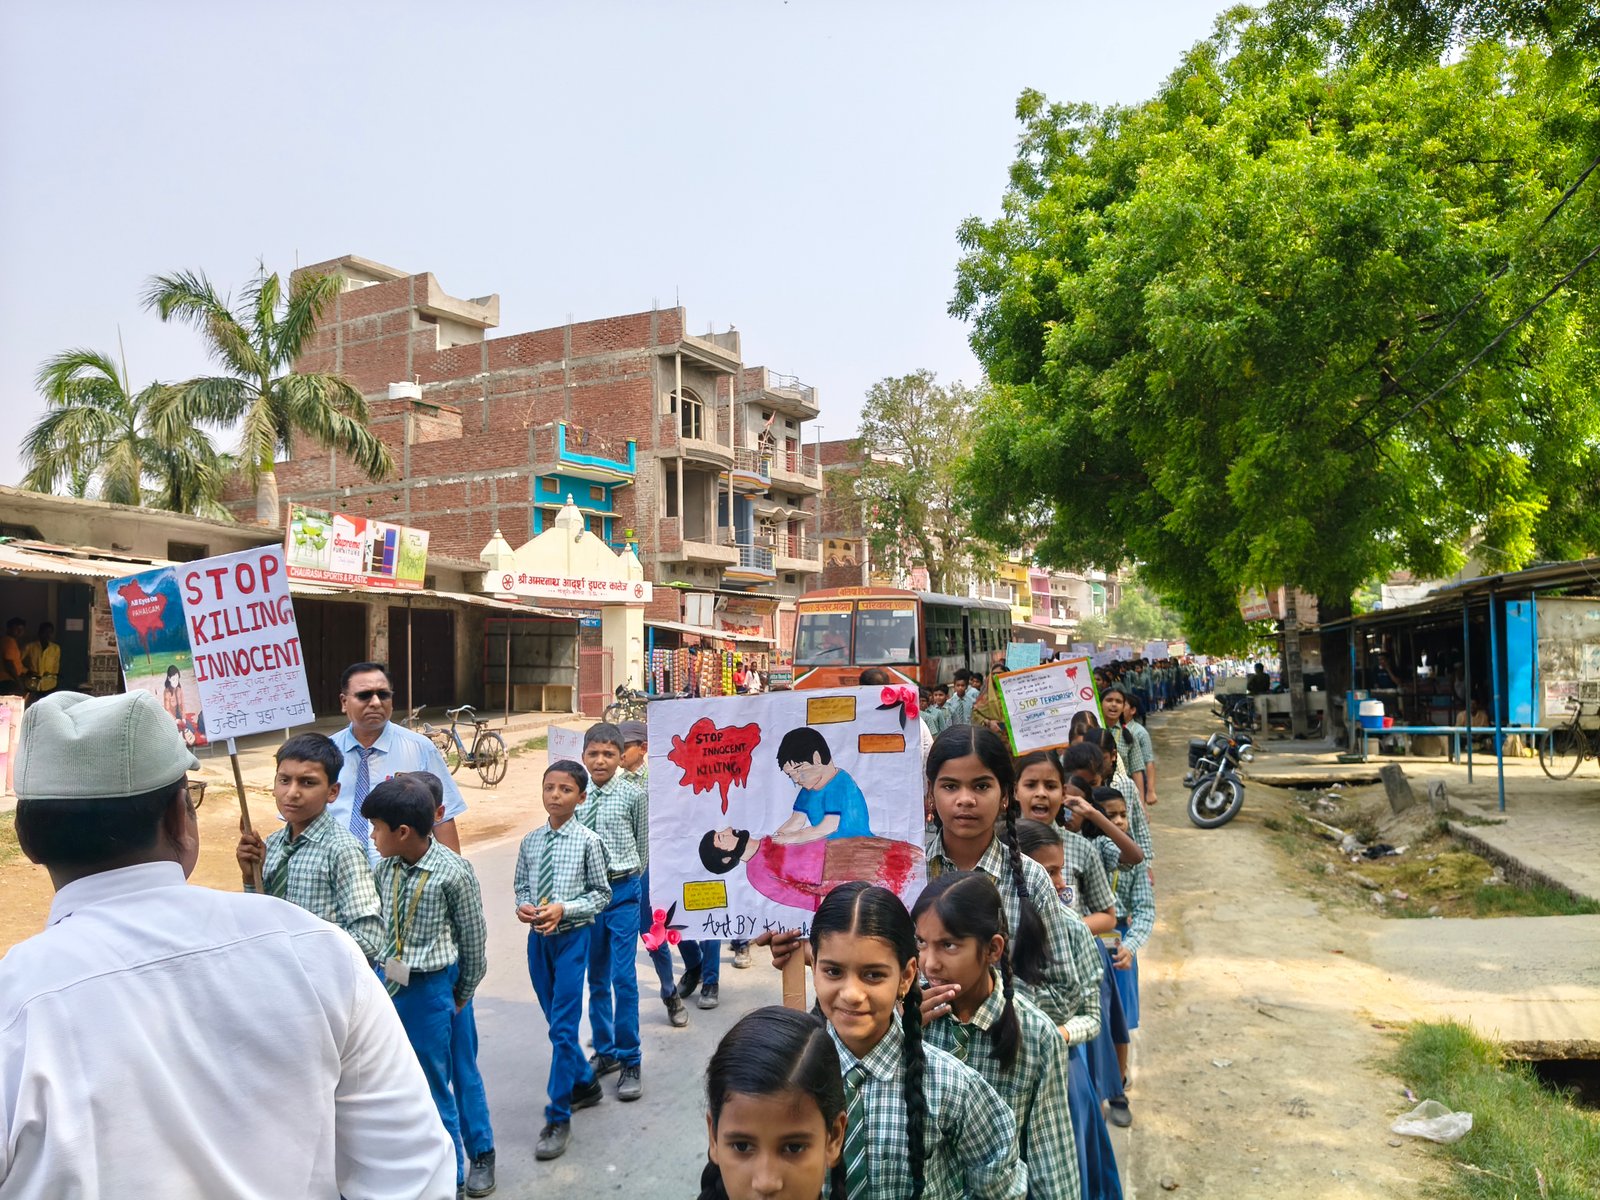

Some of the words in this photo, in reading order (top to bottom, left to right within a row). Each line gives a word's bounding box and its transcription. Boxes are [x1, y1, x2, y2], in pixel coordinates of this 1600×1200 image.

[185, 554, 279, 606] STOP
[290, 567, 324, 581] CHAURASIA
[324, 573, 344, 582] SPORTS
[348, 576, 368, 584] PLASTIC
[518, 572, 527, 585] श्री
[562, 577, 585, 589] आदर्श
[191, 595, 295, 647] KILLING
[195, 637, 301, 683] INNOCENT
[1019, 697, 1039, 711] STOP
[1040, 691, 1074, 705] TERRORISM
[696, 732, 724, 745] STOP
[702, 742, 746, 757] INNOCENT
[696, 761, 742, 776] KILLING
[734, 914, 757, 936] BY
